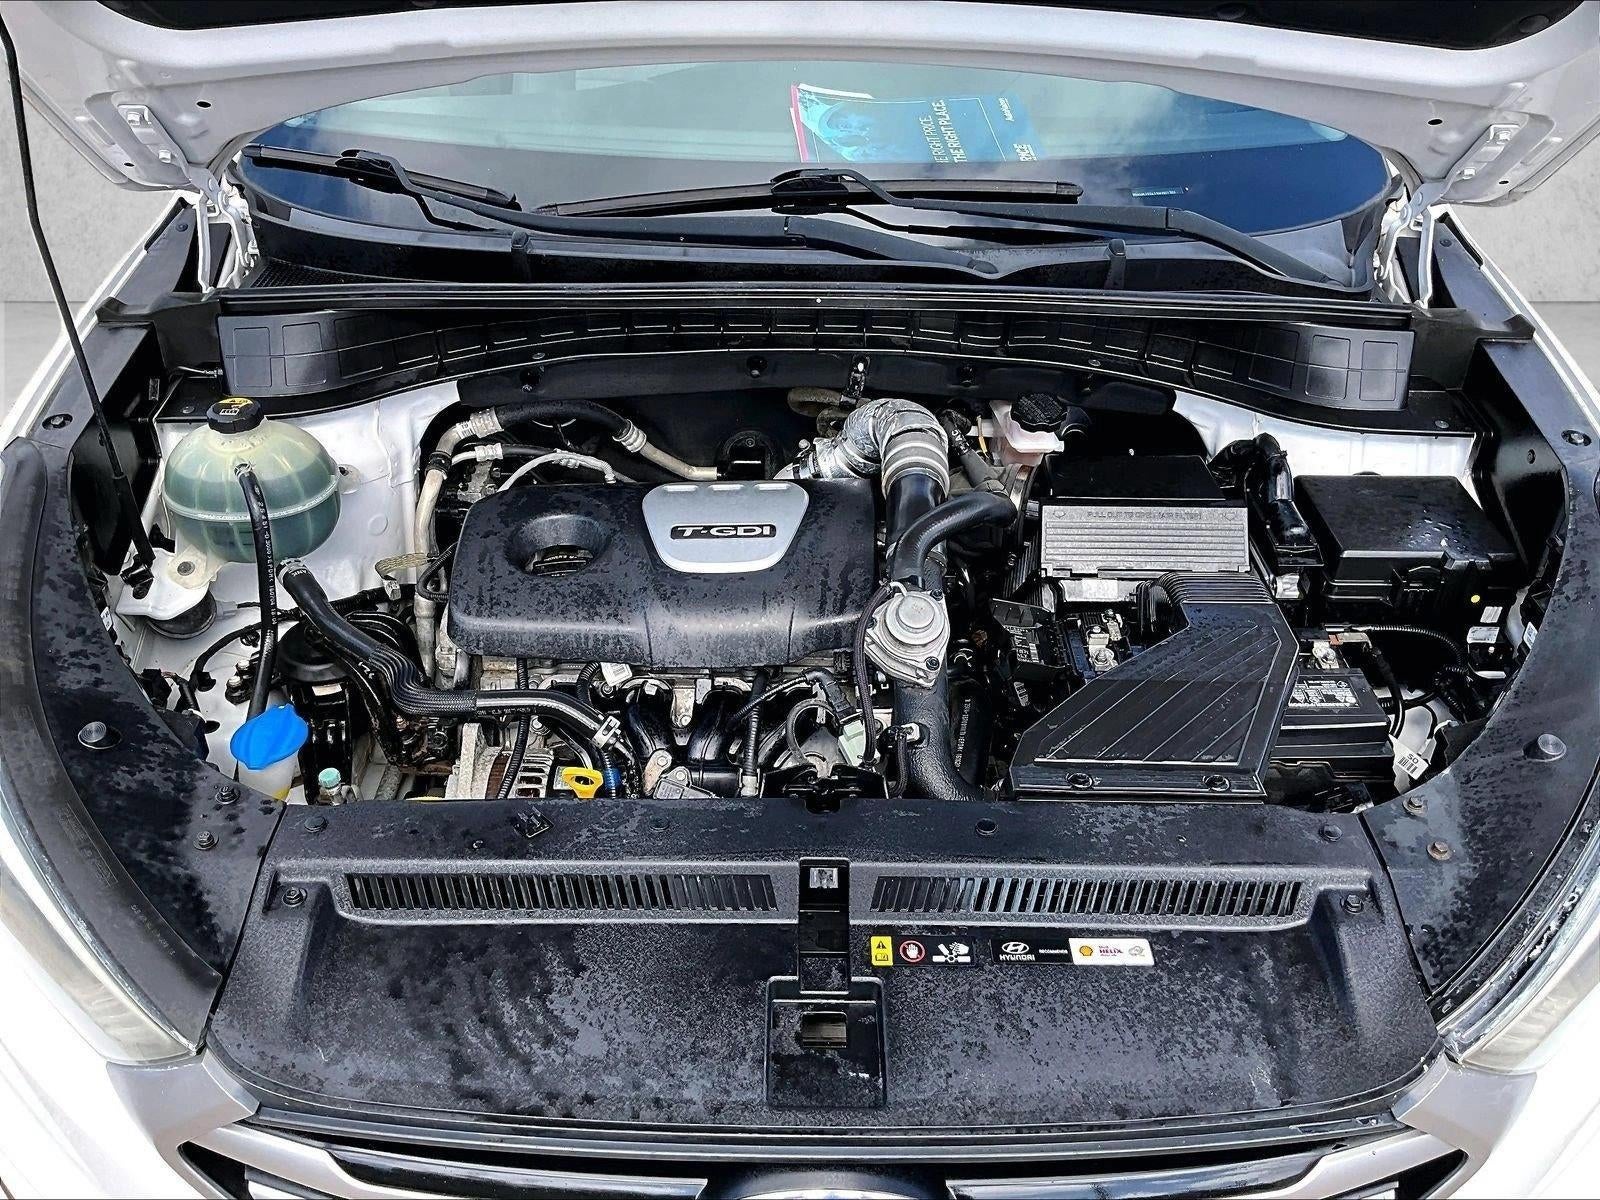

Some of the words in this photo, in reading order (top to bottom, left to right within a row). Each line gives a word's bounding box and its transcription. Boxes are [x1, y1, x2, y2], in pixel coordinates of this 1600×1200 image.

[926, 136, 946, 156] RIGHT
[941, 126, 962, 149] RIGHT
[951, 148, 968, 163] THE
[677, 525, 771, 537] T-GDI
